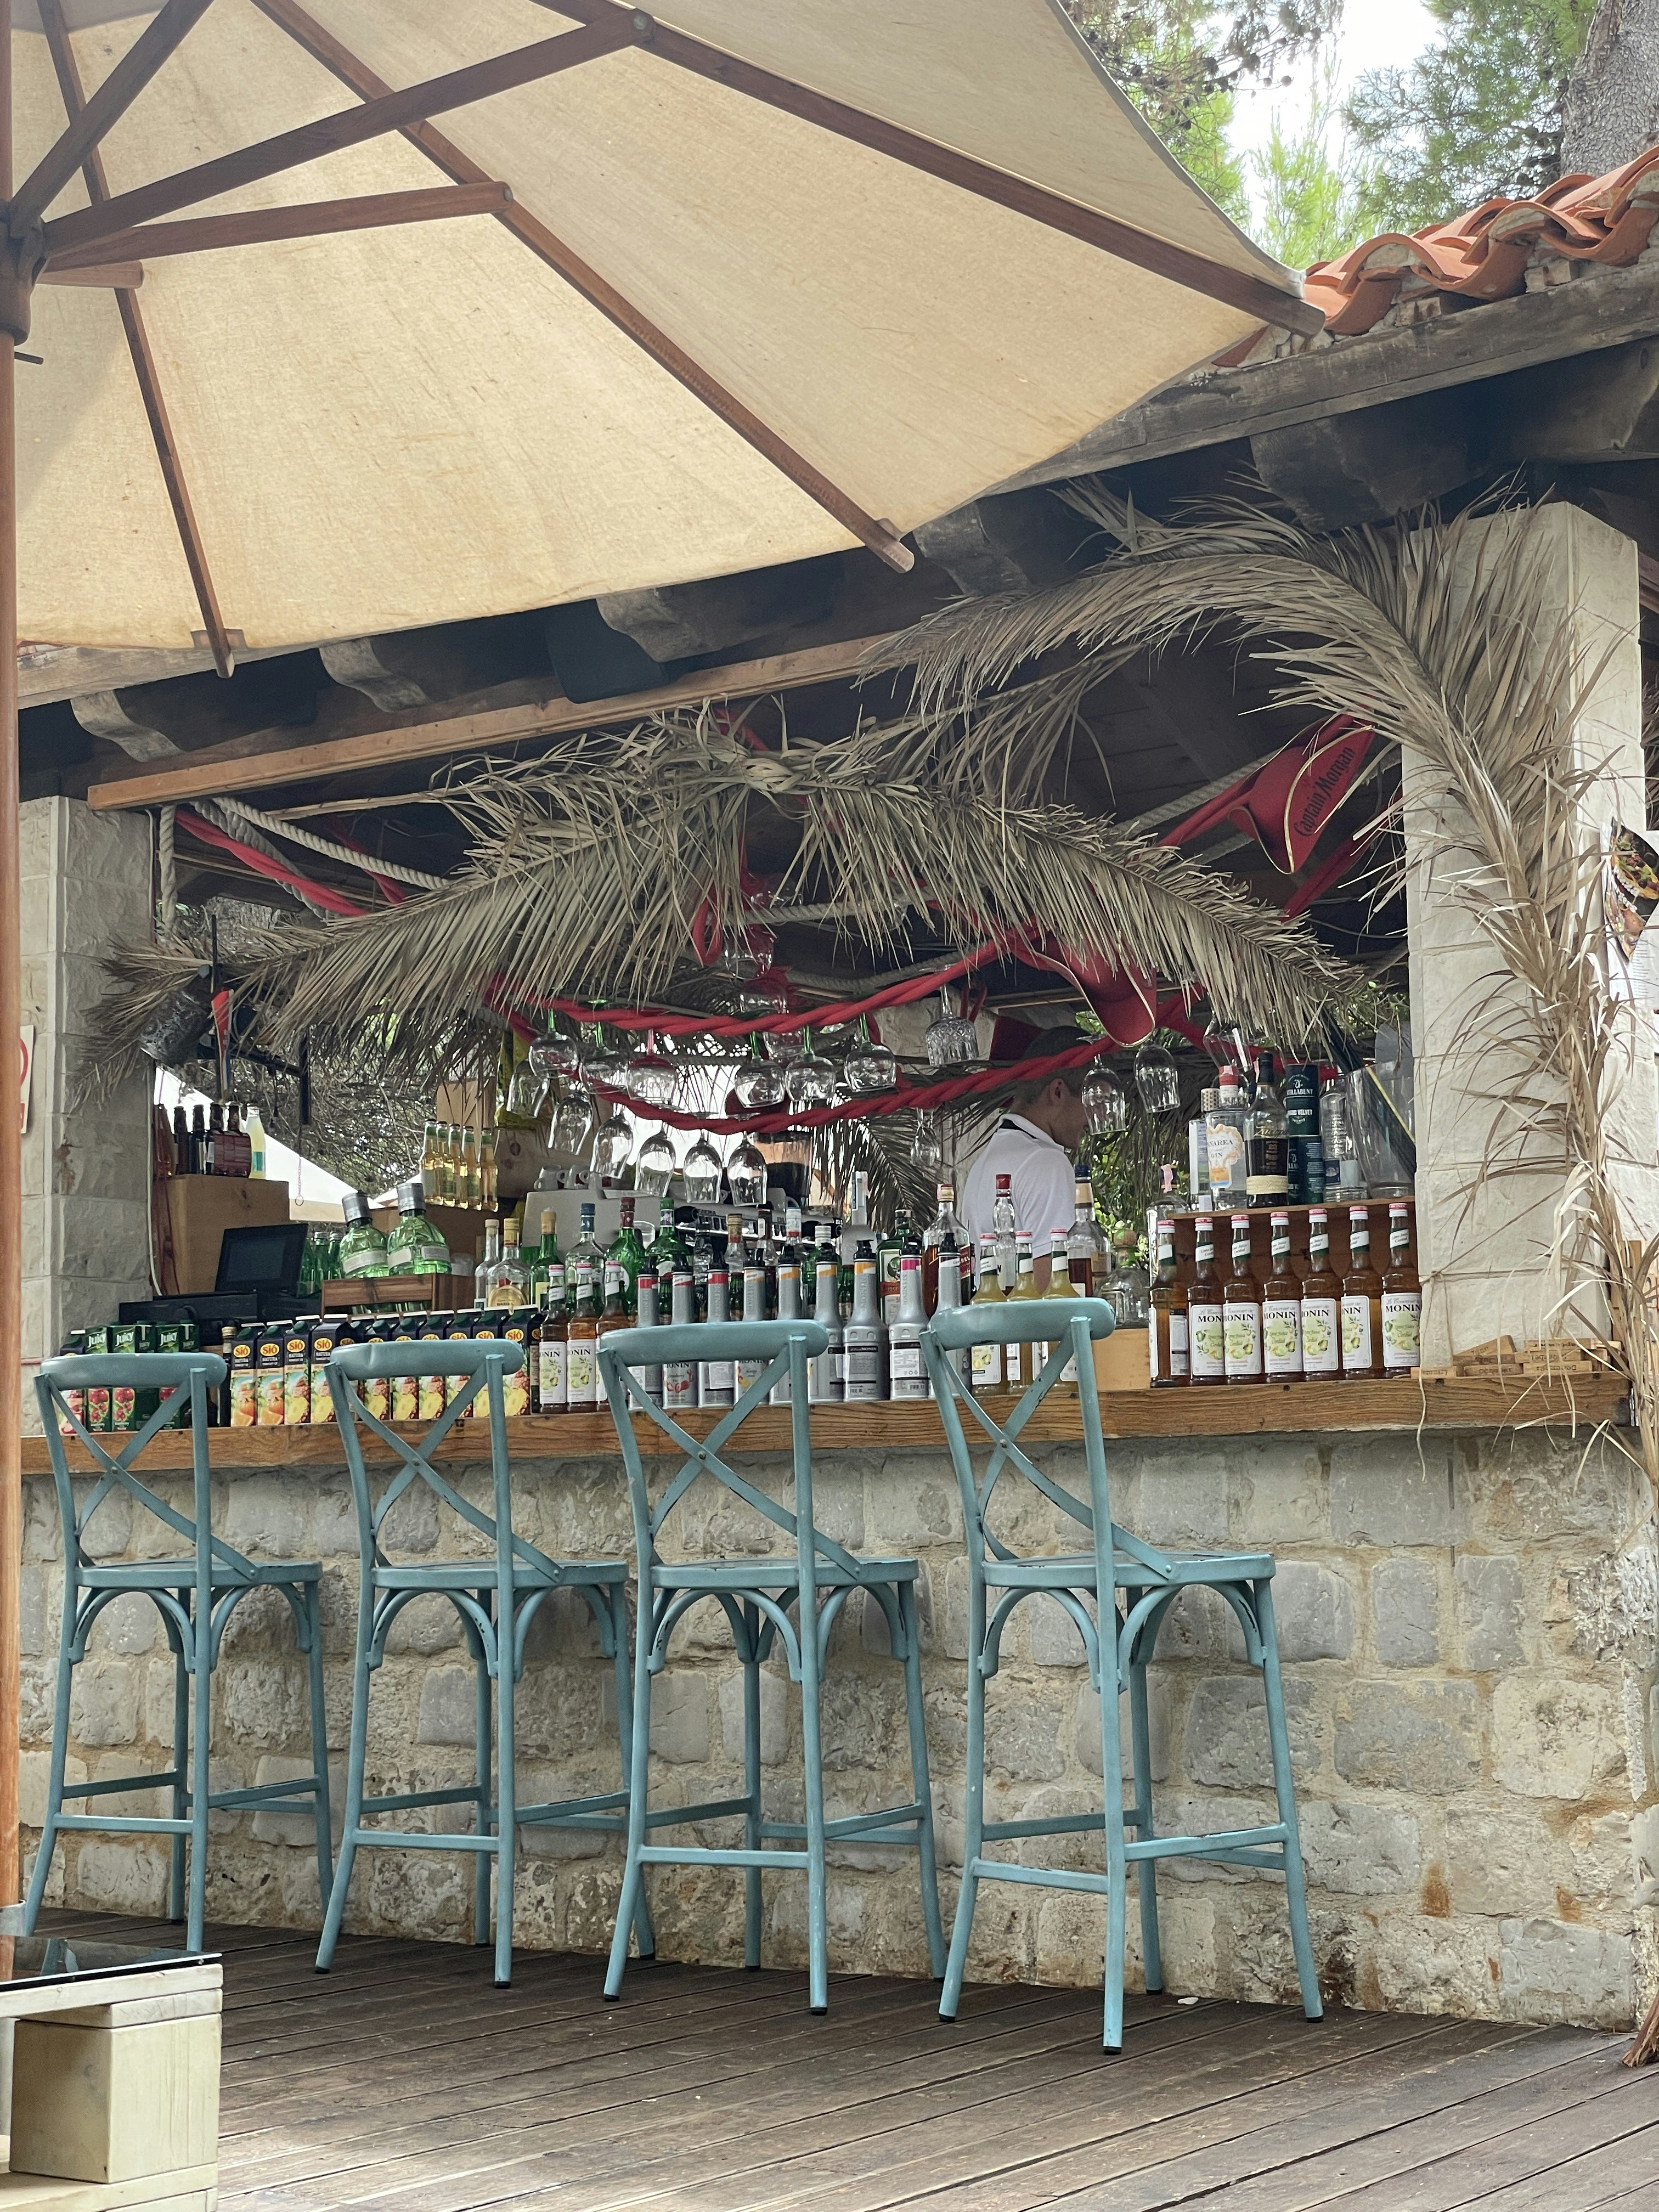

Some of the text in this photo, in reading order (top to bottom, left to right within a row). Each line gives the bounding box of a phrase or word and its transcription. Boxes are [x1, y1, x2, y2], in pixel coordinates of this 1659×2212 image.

[1294, 747, 1356, 837] Captain Morgan
[860, 1276, 869, 1308] MONIN
[1385, 1304, 1420, 1312] MONIN
[87, 1333, 106, 1348] Juicy
[115, 1331, 134, 1347] Juicy
[159, 1332, 177, 1346] Juicy
